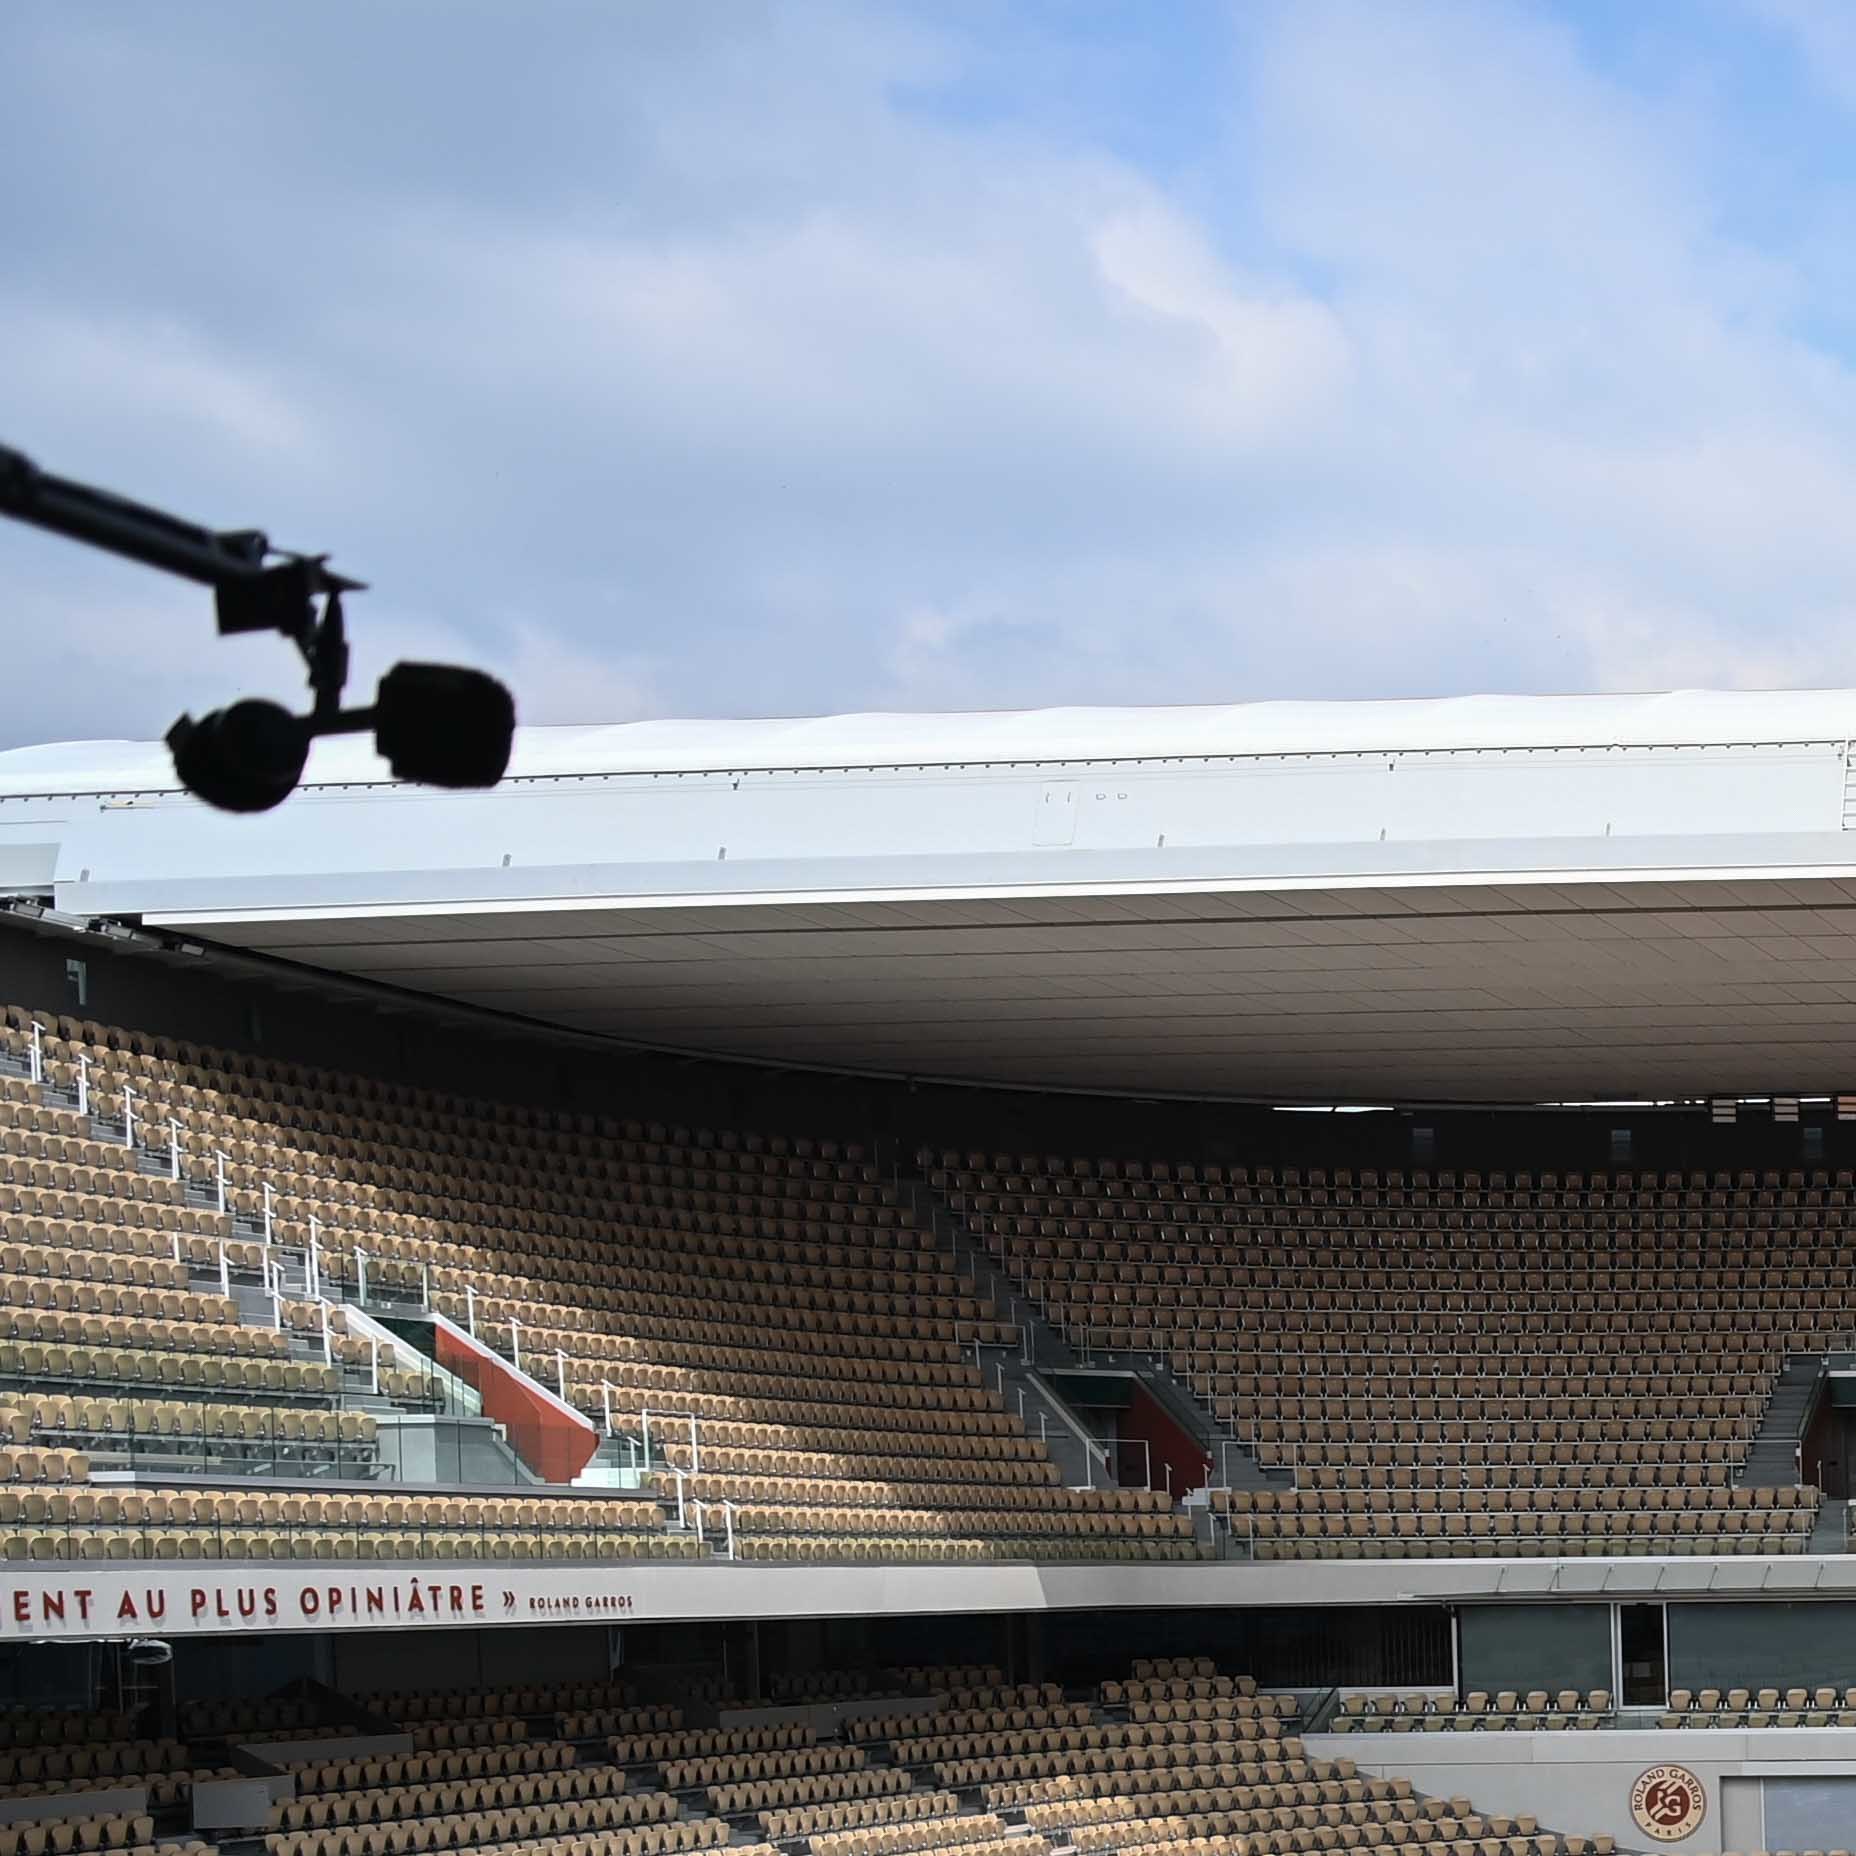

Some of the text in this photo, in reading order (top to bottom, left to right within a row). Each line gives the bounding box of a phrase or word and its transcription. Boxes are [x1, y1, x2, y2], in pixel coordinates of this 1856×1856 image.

[118, 1590, 165, 1619] AU
[191, 1587, 277, 1618] PLUS
[301, 1578, 485, 1616] OPINIÂTRE
[529, 1596, 633, 1610] ROLAND GARROS
[1634, 1769, 1701, 1811] ROLAND GARROS
